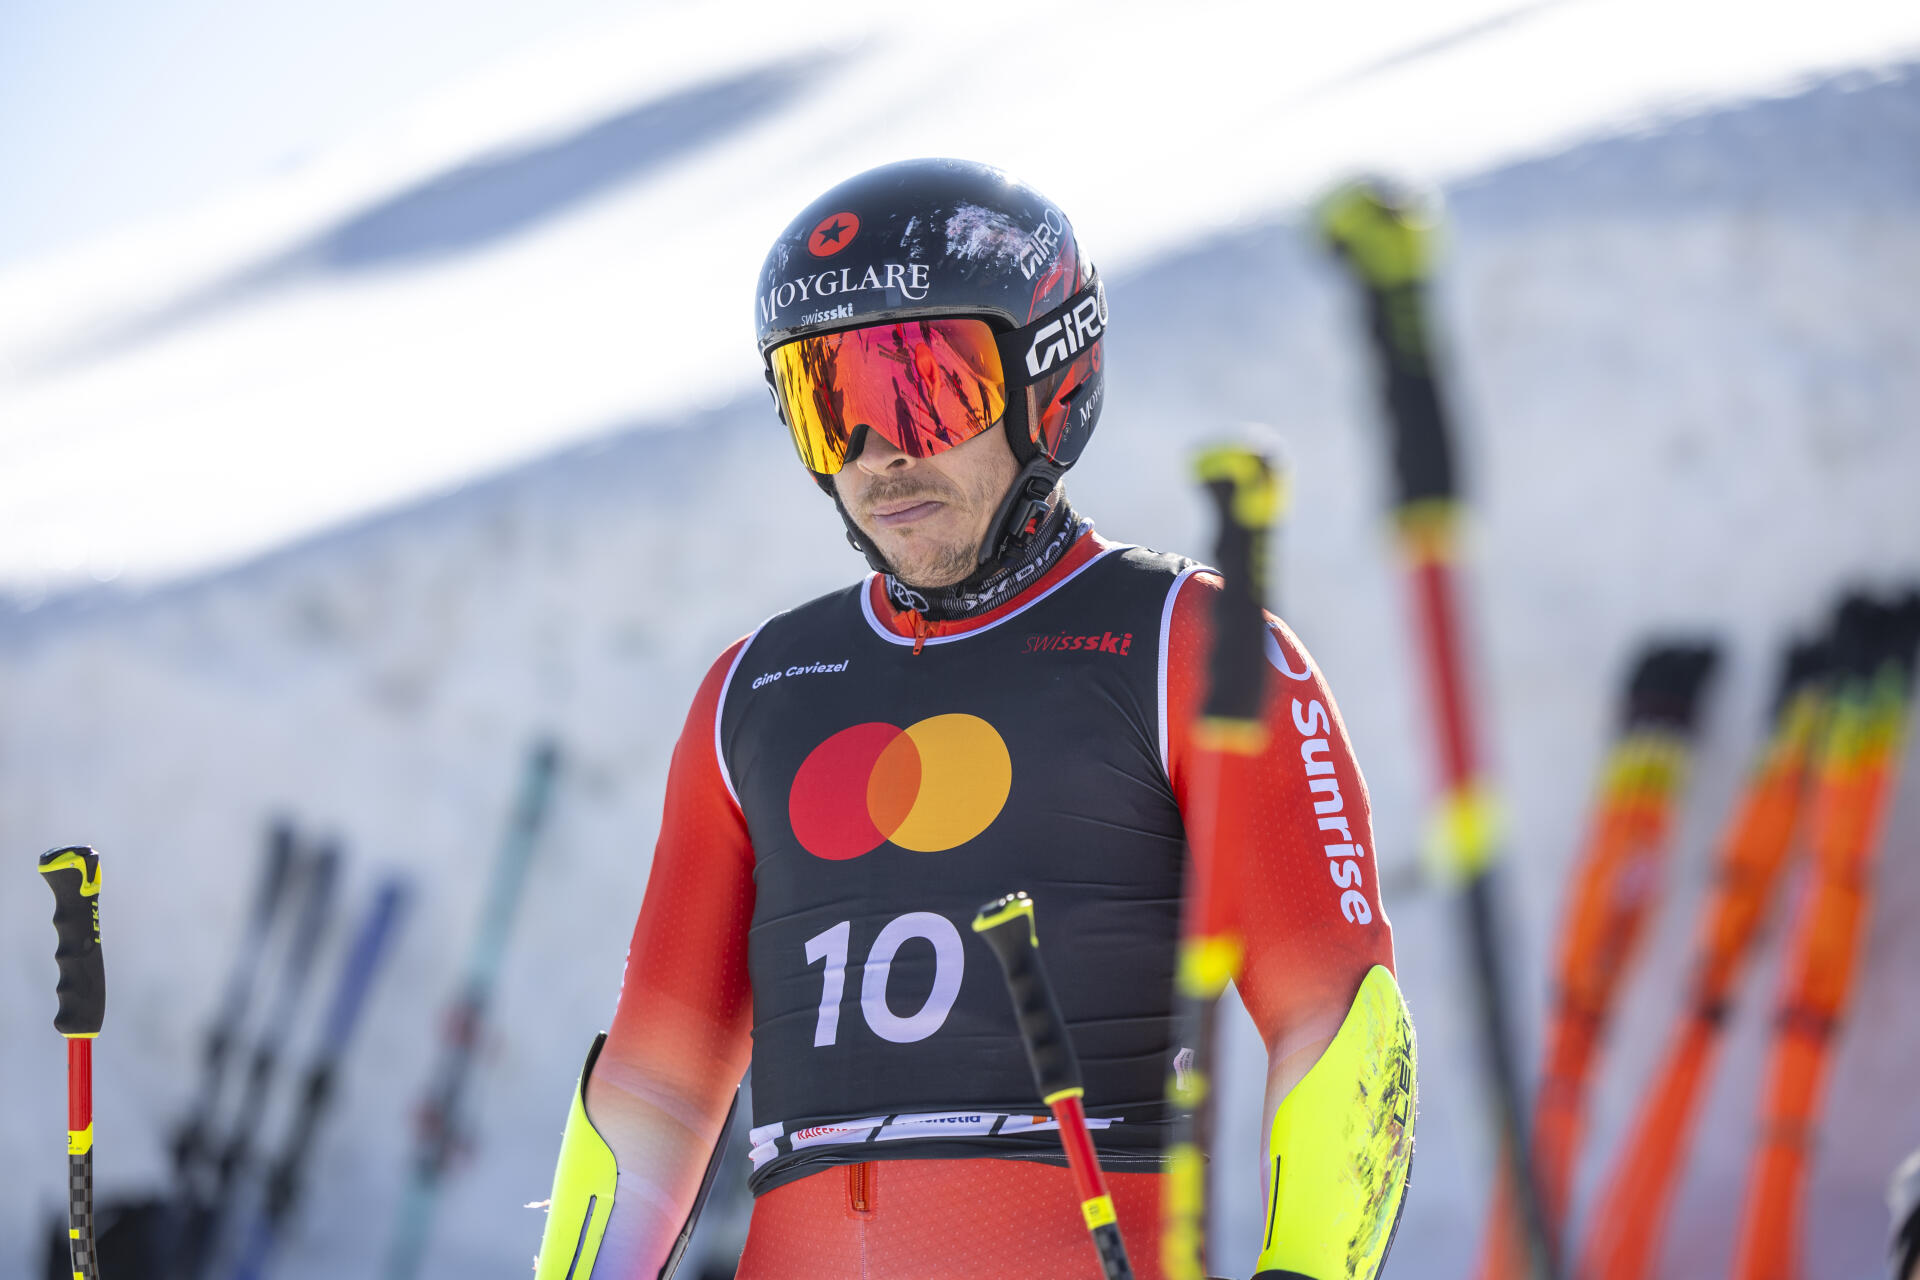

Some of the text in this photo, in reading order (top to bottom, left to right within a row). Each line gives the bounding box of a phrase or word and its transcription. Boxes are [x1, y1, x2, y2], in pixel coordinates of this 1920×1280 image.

[1020, 208, 1063, 281] GIRO
[760, 263, 930, 331] MOYGLARE
[801, 302, 854, 327] swissski
[1025, 279, 1109, 377] GIRO
[752, 659, 849, 690] Gino Caviezel
[1021, 630, 1133, 656] swissski
[1292, 698, 1373, 926] Sunrise
[805, 911, 965, 1047] 10
[1393, 1017, 1412, 1128] LEKI
